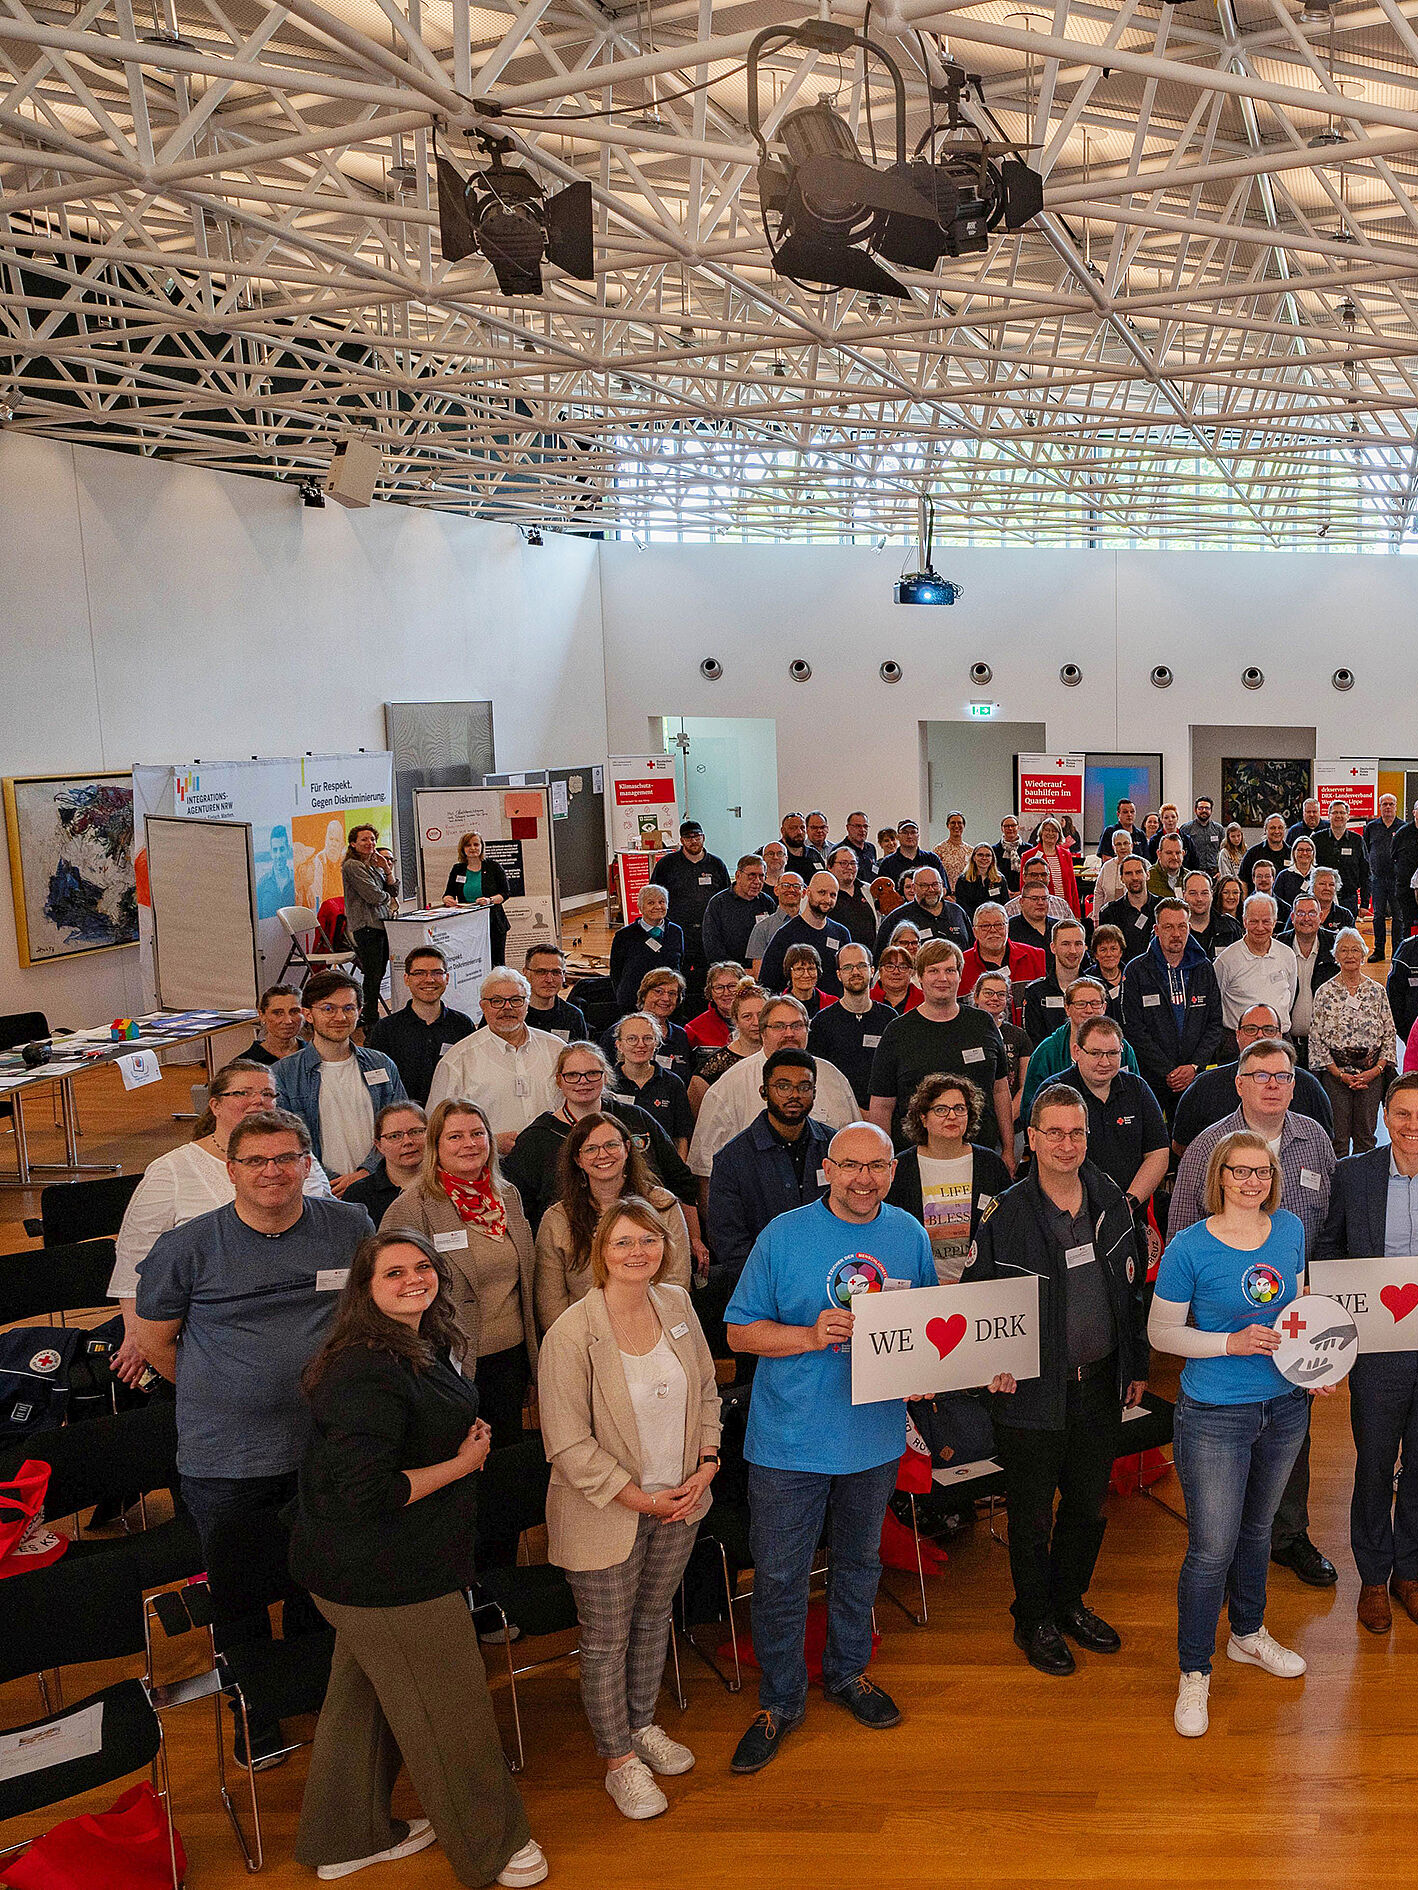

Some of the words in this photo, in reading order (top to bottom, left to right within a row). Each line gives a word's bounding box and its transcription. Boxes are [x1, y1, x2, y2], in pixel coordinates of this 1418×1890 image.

[310, 782, 322, 793] Für
[322, 780, 353, 792] Respekt.
[1024, 780, 1066, 788] Wiederauf-
[186, 792, 229, 804] INTEGRATIONS-
[311, 798, 333, 809] Gegen
[334, 792, 387, 805] Diskriminierung.
[1024, 797, 1056, 805] Quartier
[186, 803, 220, 815] AGENTUREN
[221, 802, 234, 811] NRW
[940, 1185, 971, 1197] LIFE
[1149, 1240, 1159, 1265] REUZ
[869, 1328, 914, 1355] WE
[975, 1314, 1026, 1342] DRK
